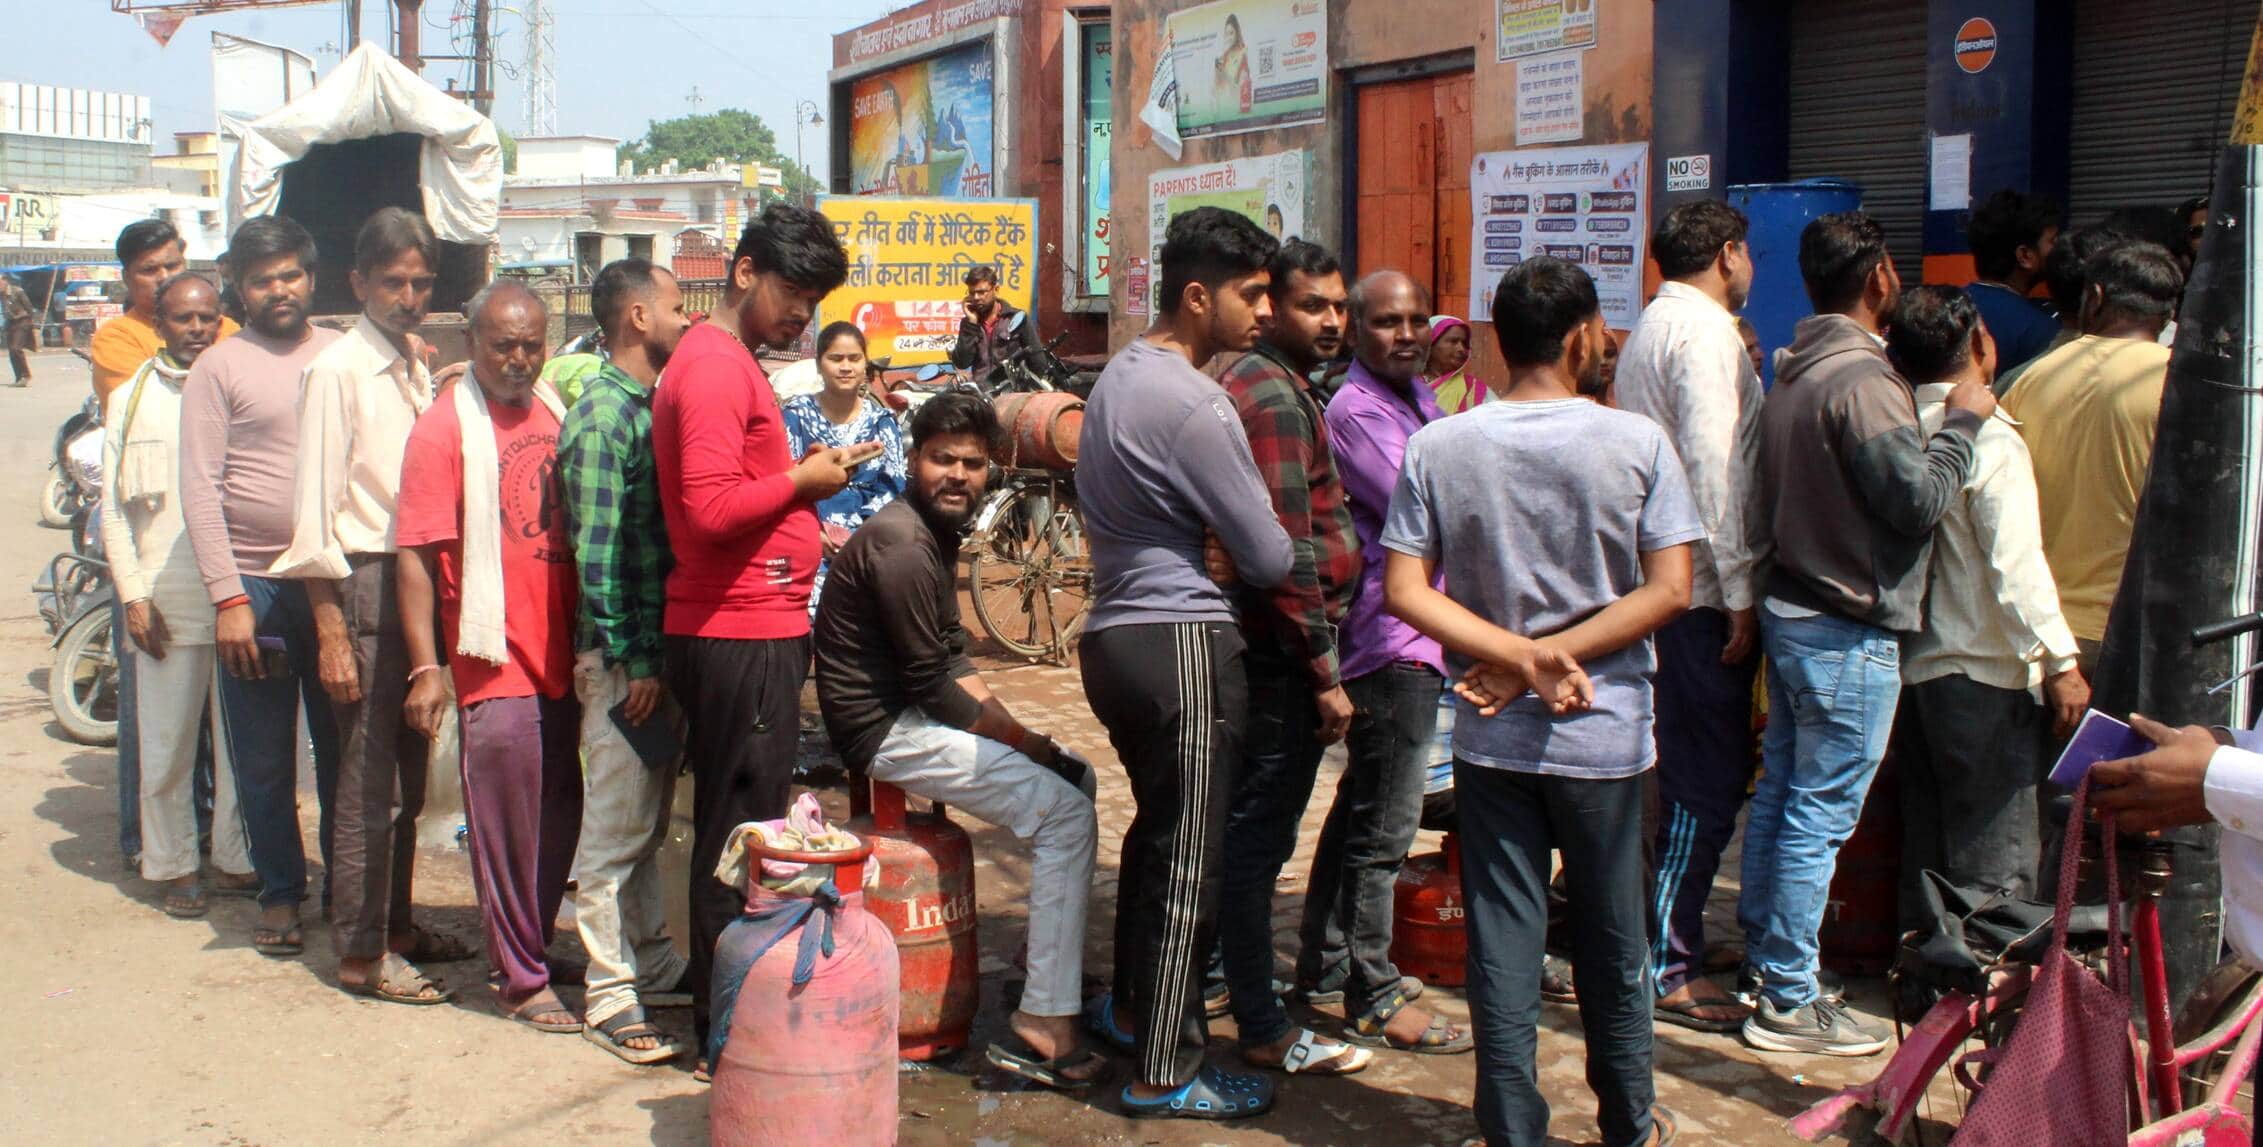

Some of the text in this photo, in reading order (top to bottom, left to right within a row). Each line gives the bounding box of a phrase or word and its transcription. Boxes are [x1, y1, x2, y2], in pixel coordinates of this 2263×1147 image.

[969, 60, 992, 84] SAVE
[854, 89, 894, 118] SAVE EARTH
[1669, 160, 1689, 176] NO
[1154, 177, 1198, 198] PARENTS
[1200, 170, 1223, 191] ध्यान
[1668, 179, 1708, 190] SMOKING
[896, 210, 922, 245] वर्ष
[923, 213, 938, 246] में
[995, 214, 1026, 247] टैंक
[876, 262, 932, 287] कराना
[1008, 254, 1025, 290] है
[901, 894, 972, 932] Inda
